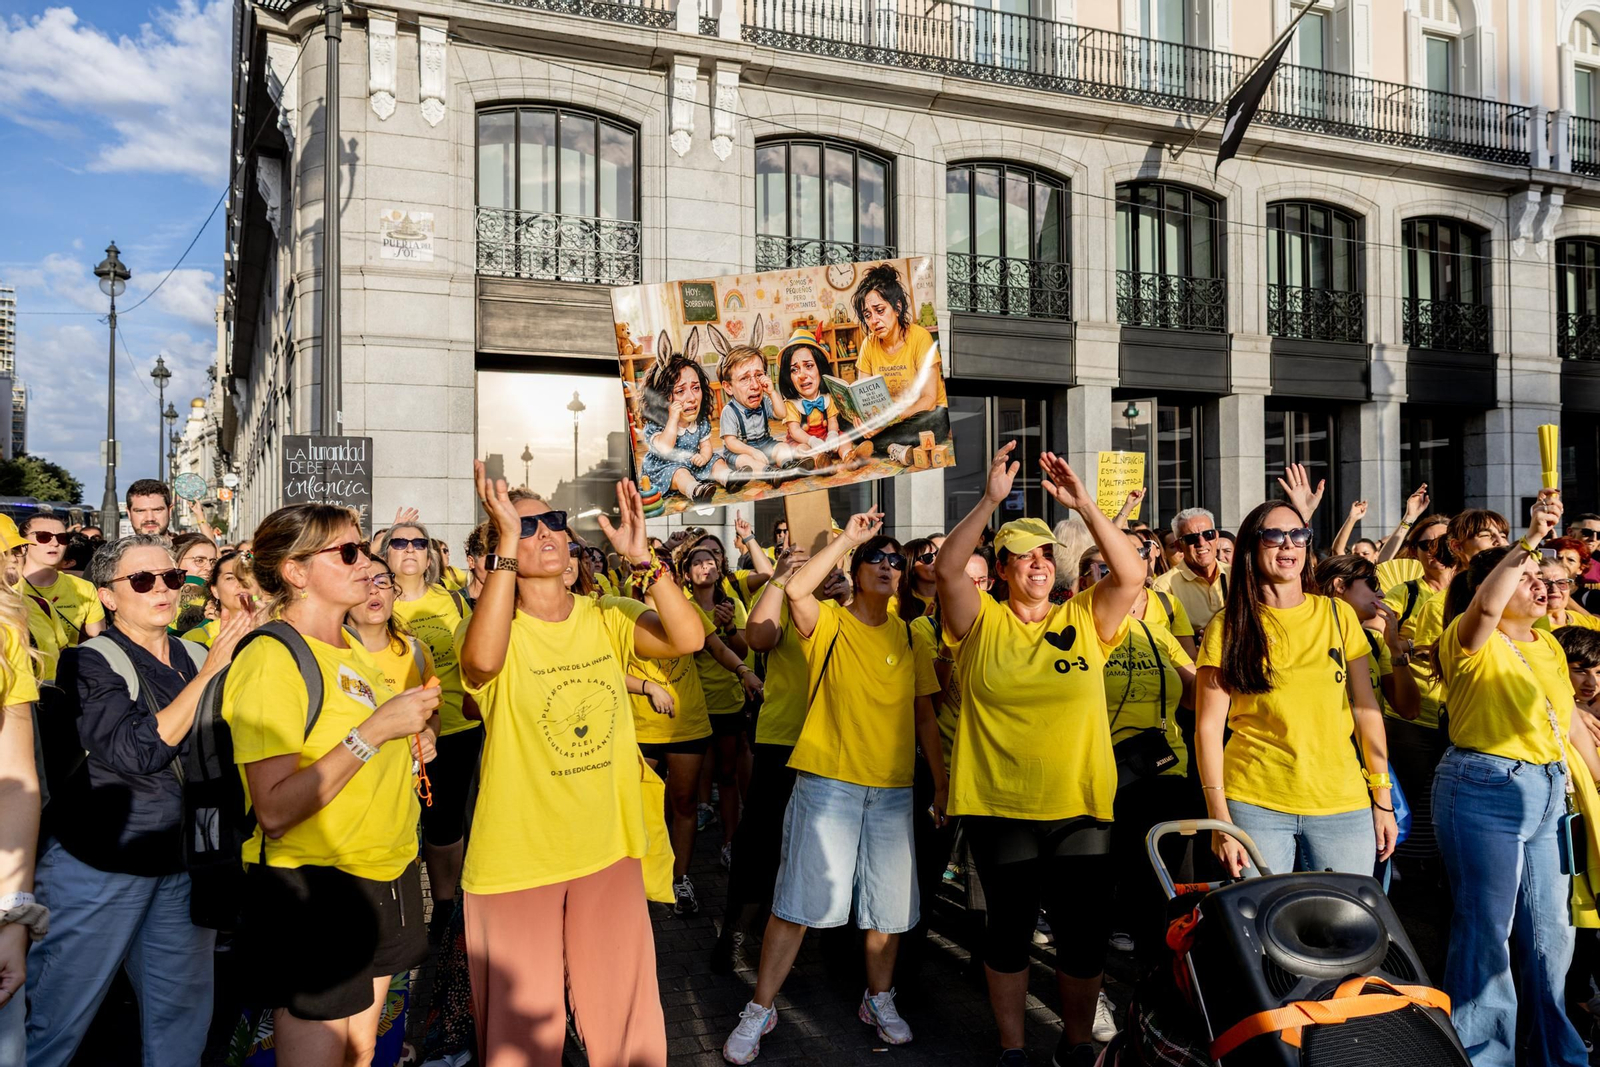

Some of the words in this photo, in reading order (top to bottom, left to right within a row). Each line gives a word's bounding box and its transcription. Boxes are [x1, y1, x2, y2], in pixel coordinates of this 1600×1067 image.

[383, 239, 420, 249] PUERTA
[394, 246, 417, 258] SOL
[685, 287, 701, 296] HOY:
[685, 300, 716, 308] SOBREVIVIR
[785, 301, 816, 310] IMPORTANTES
[858, 382, 880, 394] ALICIA
[925, 438, 932, 447] A
[286, 448, 307, 460] LA
[309, 438, 365, 461] humanidad
[290, 461, 324, 474] DEBE
[331, 462, 342, 474] A
[345, 462, 365, 475] LA
[284, 475, 369, 499] infancia
[1099, 478, 1142, 487] MALTRATADA
[592, 654, 612, 665] INFAN
[1054, 656, 1089, 674] 0-3
[1335, 671, 1347, 683] 0-
[541, 678, 582, 719] PLATAFORMA
[543, 725, 575, 758] ESCUELAS
[571, 739, 593, 747] PLEI
